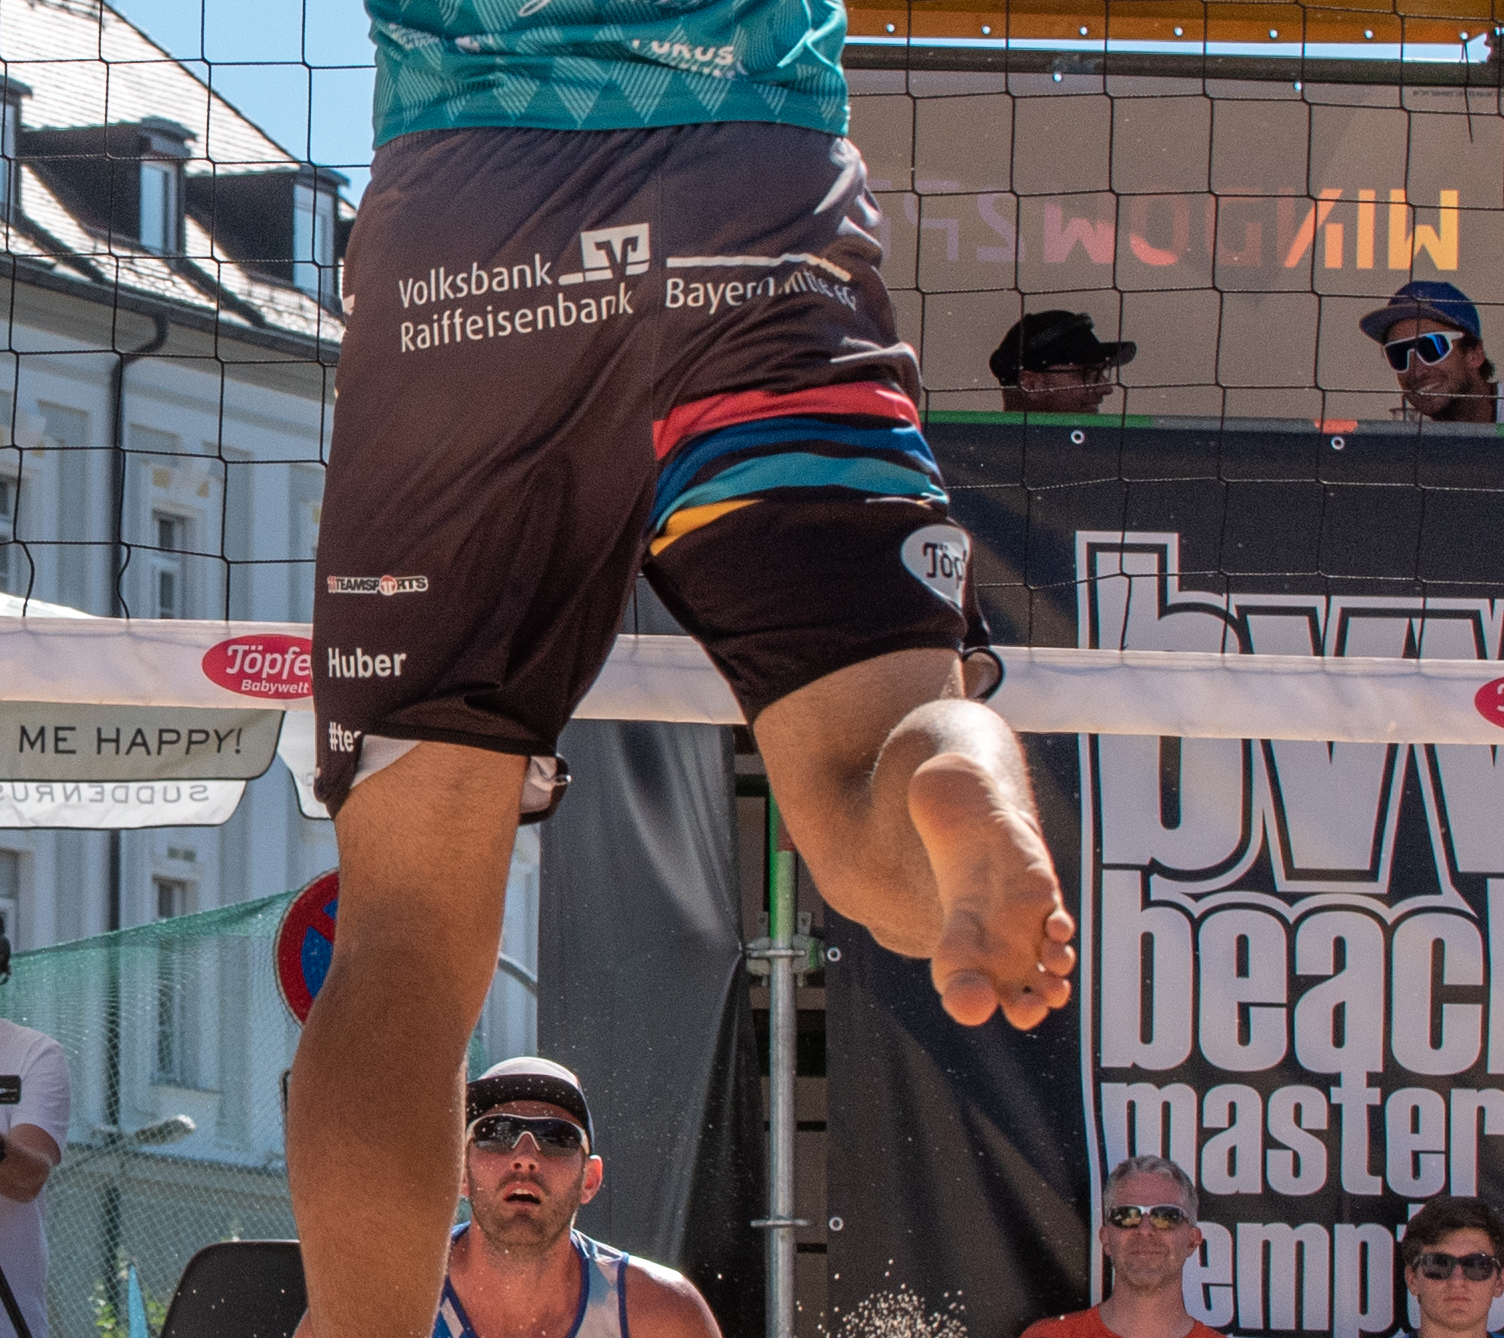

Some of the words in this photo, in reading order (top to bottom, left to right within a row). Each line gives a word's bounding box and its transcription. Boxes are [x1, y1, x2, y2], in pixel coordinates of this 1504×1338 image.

[398, 253, 554, 311] Volksbank
[400, 282, 634, 354] Raiffeisenbank
[225, 644, 313, 680] Töpfe
[327, 647, 407, 679] Huber
[240, 679, 310, 695] Babywelt
[17, 725, 77, 755] ME
[95, 727, 242, 757] HAPPY!
